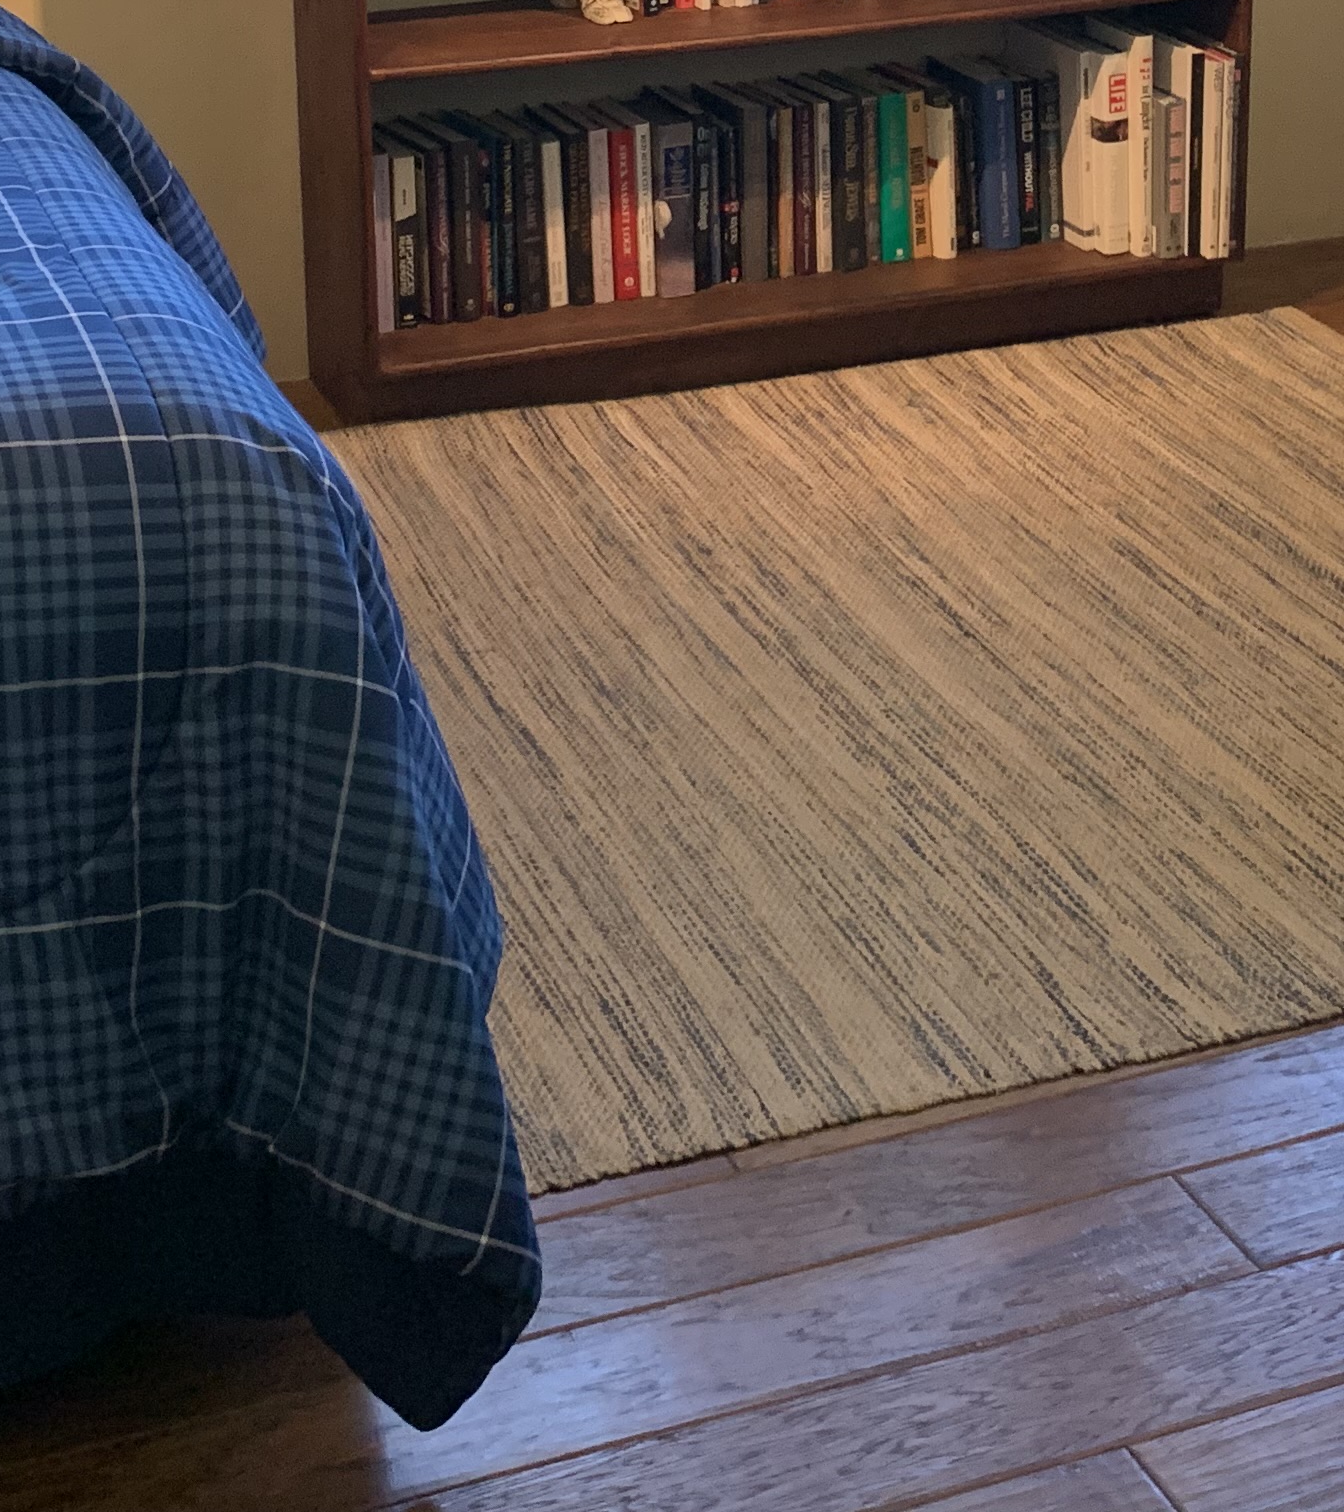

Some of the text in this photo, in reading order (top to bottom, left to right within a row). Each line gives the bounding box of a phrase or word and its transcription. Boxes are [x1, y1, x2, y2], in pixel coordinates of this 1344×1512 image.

[1139, 58, 1152, 80] LIFE
[1020, 87, 1034, 143] LEE CHILD
[1110, 75, 1126, 112] LIFE
[620, 181, 631, 224] MARKET
[912, 197, 926, 246] TOM GRACE
